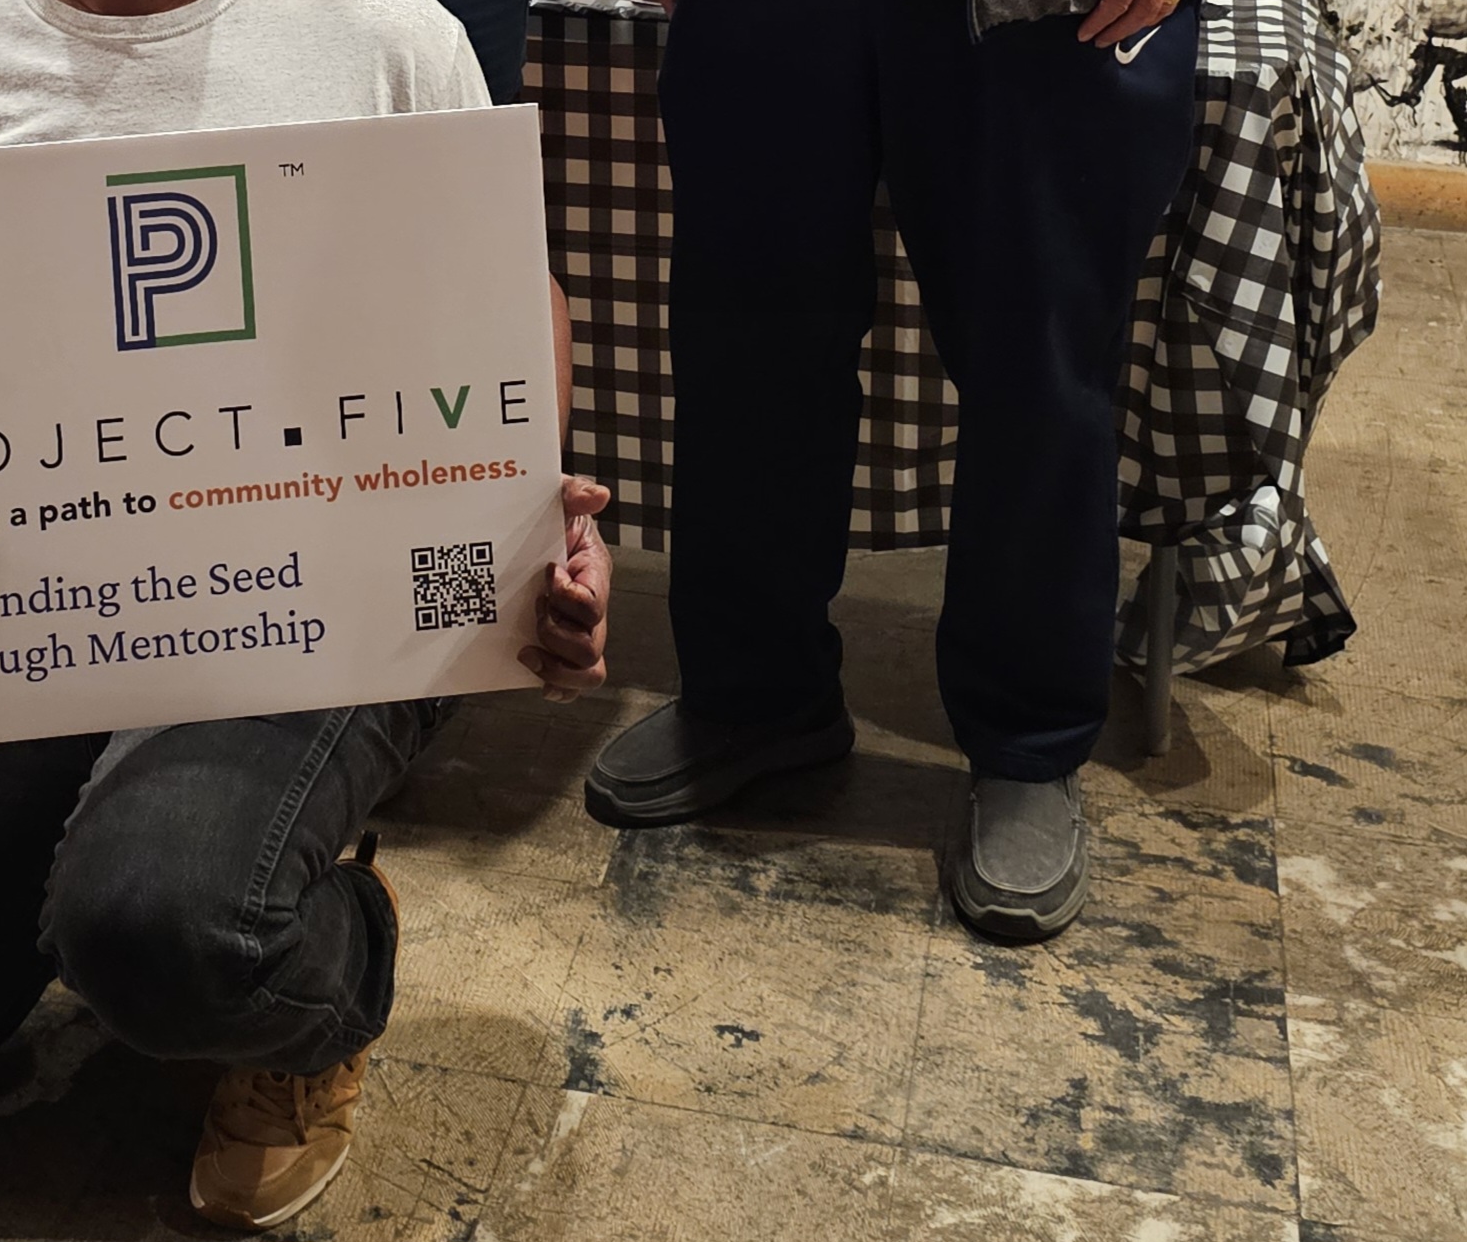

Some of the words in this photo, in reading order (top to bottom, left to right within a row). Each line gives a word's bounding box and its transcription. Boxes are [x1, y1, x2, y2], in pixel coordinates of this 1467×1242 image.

[278, 162, 305, 178] TM
[10, 507, 28, 527] a
[39, 490, 112, 531] path
[122, 492, 157, 515] to
[169, 472, 343, 511] community
[354, 459, 527, 492] wholeness.
[130, 565, 198, 604] the
[209, 551, 304, 595] Seed
[87, 608, 327, 666] Mentorship
